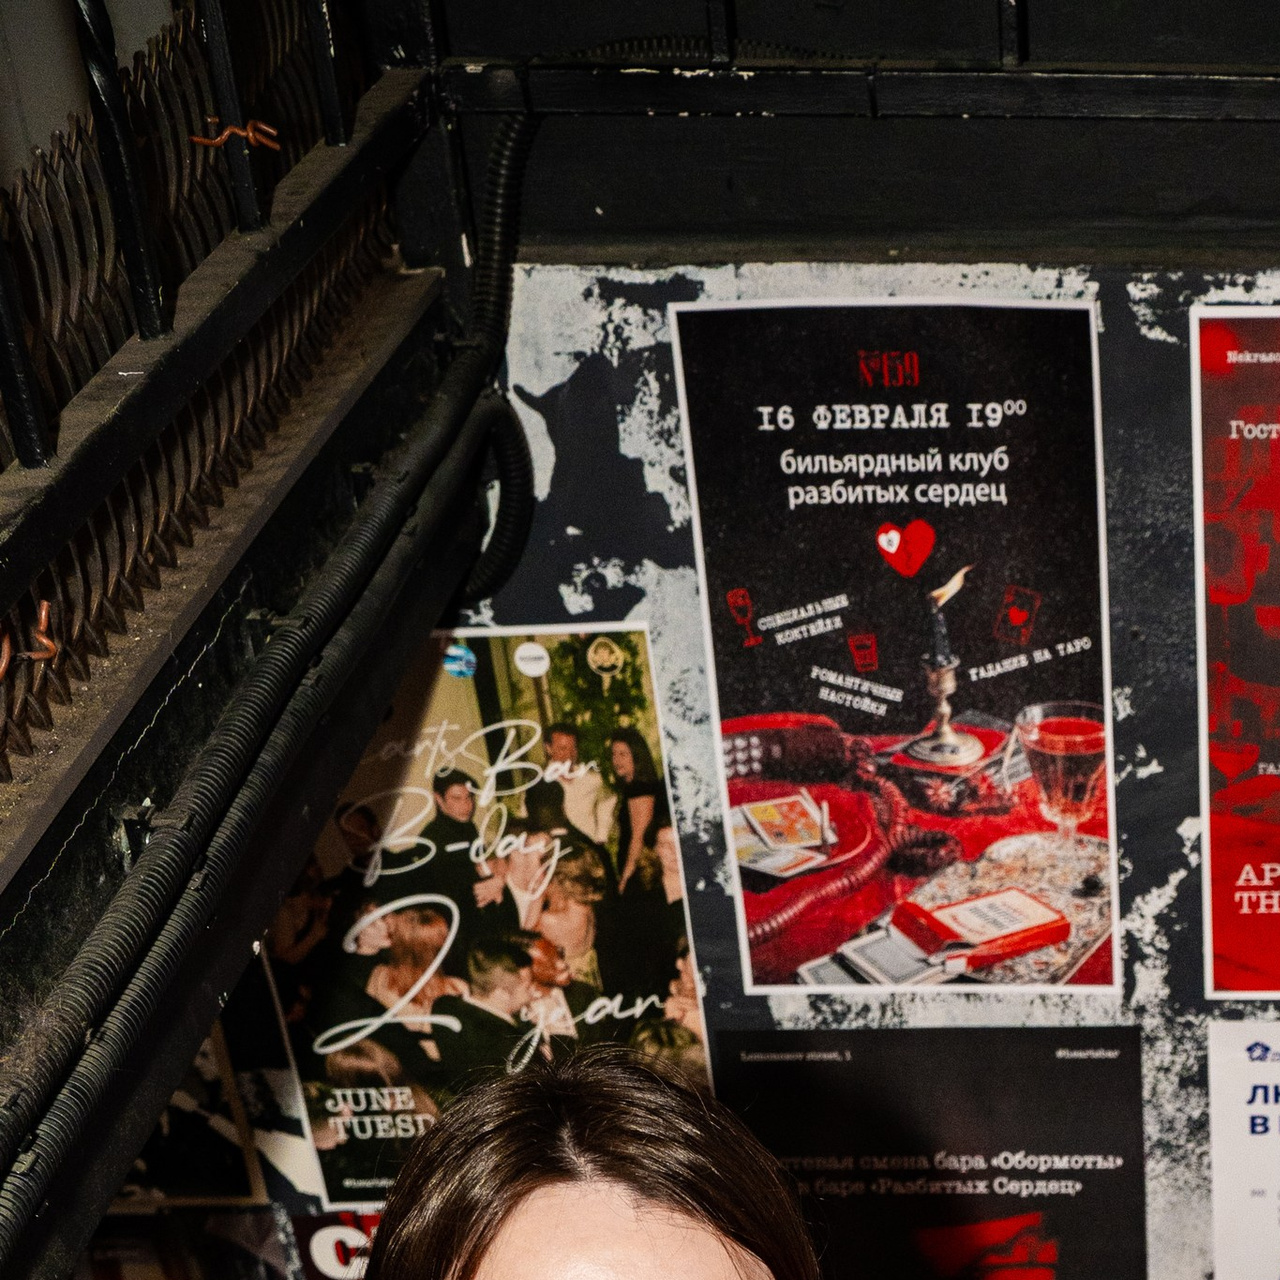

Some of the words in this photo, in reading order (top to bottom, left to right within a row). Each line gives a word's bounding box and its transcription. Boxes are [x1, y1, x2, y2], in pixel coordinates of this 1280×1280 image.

[756, 406, 795, 432] 16
[813, 402, 950, 431] ФЕВРАЛЯ
[780, 448, 943, 477] бильярдный
[949, 446, 1010, 474] клуб
[789, 480, 909, 510] разбитых
[914, 480, 1007, 508] сердец
[775, 616, 843, 645] КОКТЕЙЛИ
[968, 654, 1028, 682] ГАДАНИЕ
[1033, 649, 1052, 663] НА
[1055, 637, 1092, 657] ТАРО
[818, 687, 887, 717] НАСТОЙКИ
[455, 717, 600, 806] Bar
[312, 893, 462, 1055] 2
[506, 993, 667, 1074] year
[325, 1087, 415, 1113] JUNE
[1249, 1115, 1269, 1135] в
[859, 1153, 930, 1170] смена
[933, 1153, 988, 1170] бара
[991, 1151, 1123, 1171] «Обормоты»
[814, 1177, 867, 1196] баре
[870, 1176, 989, 1195] «Разбитых
[992, 1177, 1083, 1197] Сердец»
